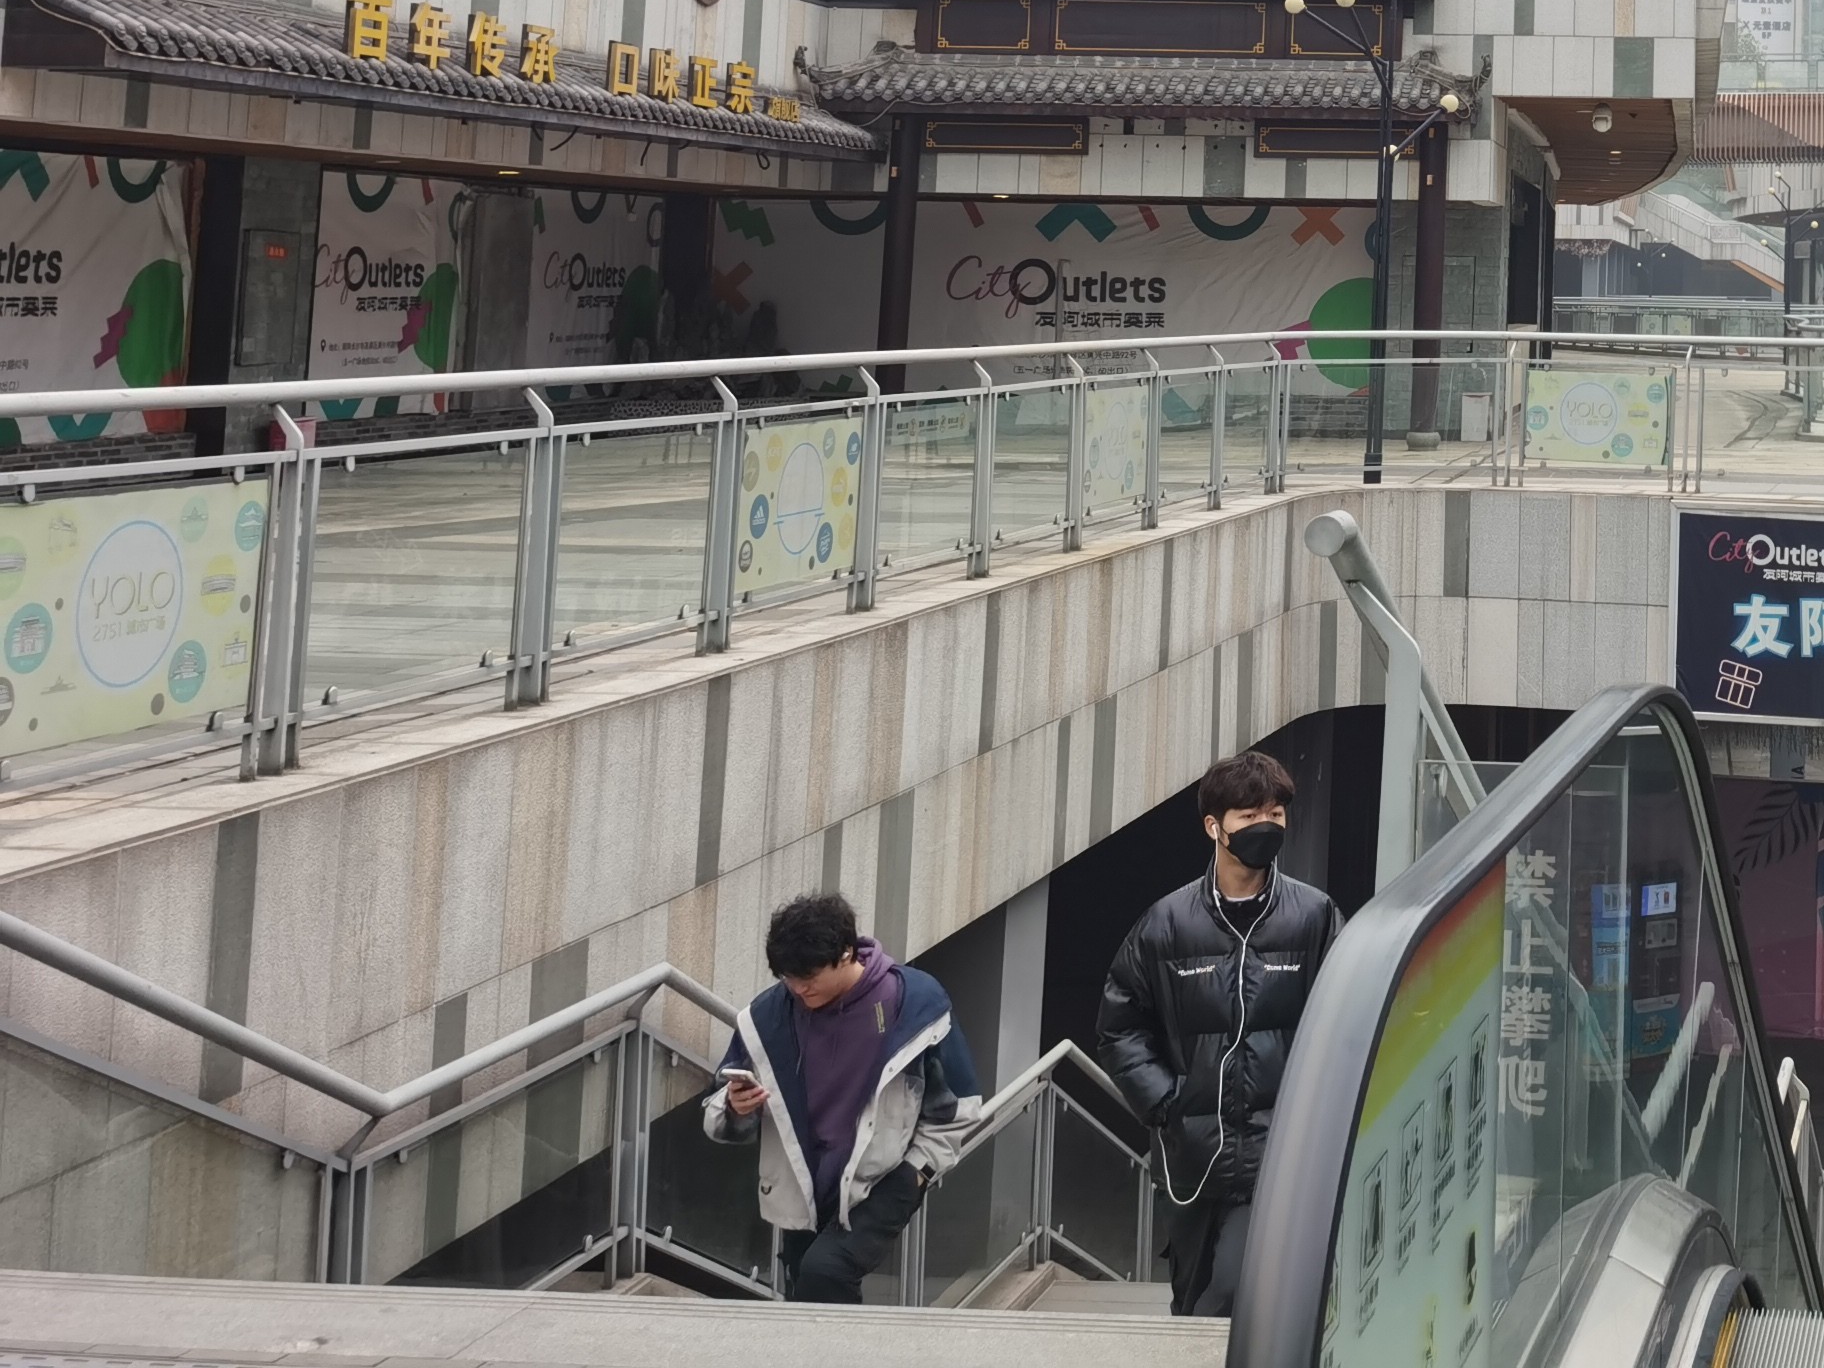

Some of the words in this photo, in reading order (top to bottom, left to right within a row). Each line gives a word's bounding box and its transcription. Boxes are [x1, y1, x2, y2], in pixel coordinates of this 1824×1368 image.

[608, 40, 756, 113] 口味正宗
[344, 246, 425, 291] Outlets
[946, 255, 1032, 319] City
[1009, 258, 1167, 305] Outlets
[1035, 311, 1165, 329] 友阿城市奥莱
[1567, 401, 1614, 419] YOLO
[1708, 531, 1760, 573] City
[91, 571, 176, 619] YOLO
